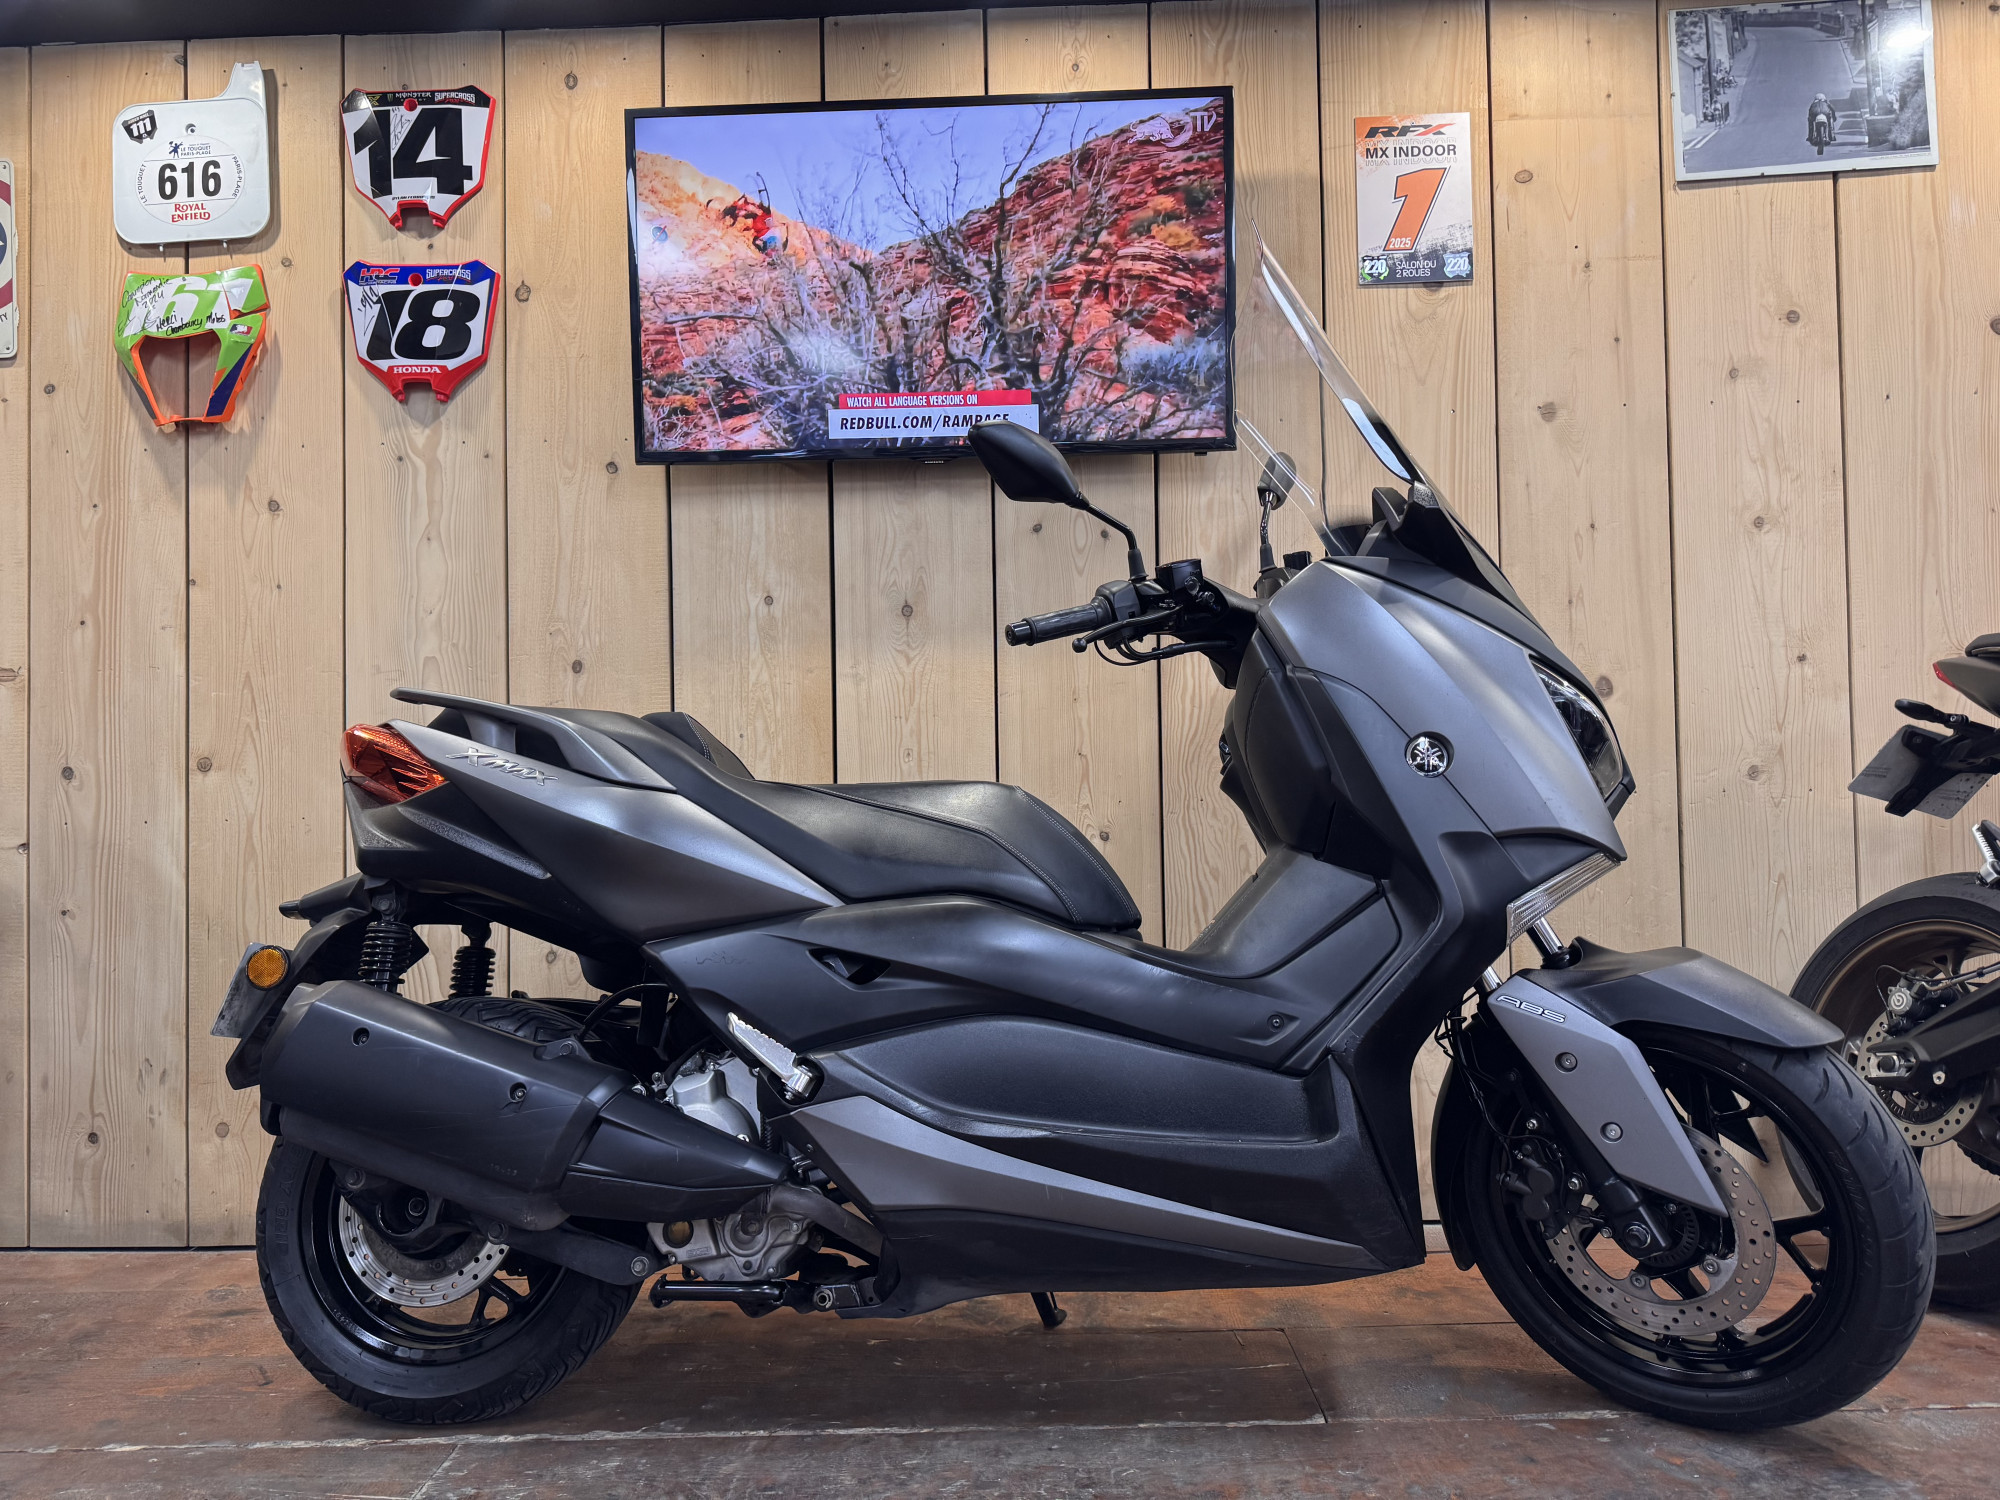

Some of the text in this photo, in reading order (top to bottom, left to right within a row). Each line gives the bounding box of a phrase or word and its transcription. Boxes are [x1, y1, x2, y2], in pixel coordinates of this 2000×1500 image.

[434, 91, 476, 104] SUPERCROSS
[130, 117, 152, 137] 111
[1190, 111, 1217, 132] TV
[1365, 123, 1457, 139] RFX
[353, 107, 473, 199] 14
[1365, 144, 1457, 160] MX INDOOR
[137, 164, 147, 195] TOUQUET
[158, 160, 222, 200] 616
[232, 155, 243, 198] PARIS-PLAGE
[174, 203, 206, 213] ROYAL
[1383, 167, 1449, 251] 1
[171, 212, 211, 222] ENFIELD
[1389, 237, 1412, 249] 2025
[1364, 259, 1387, 274] 220
[1395, 259, 1437, 269] SALON DU
[1446, 257, 1469, 271] 220
[359, 268, 400, 282] HRC
[426, 268, 471, 280] SUPERCROSS
[1396, 268, 1431, 277] 2 ROUES
[366, 289, 481, 361] 18
[393, 366, 442, 374] HONDA
[847, 394, 978, 408] WATCH ALL LANGUAGE VERSIONS ON
[1496, 995, 1566, 1023] ABS
